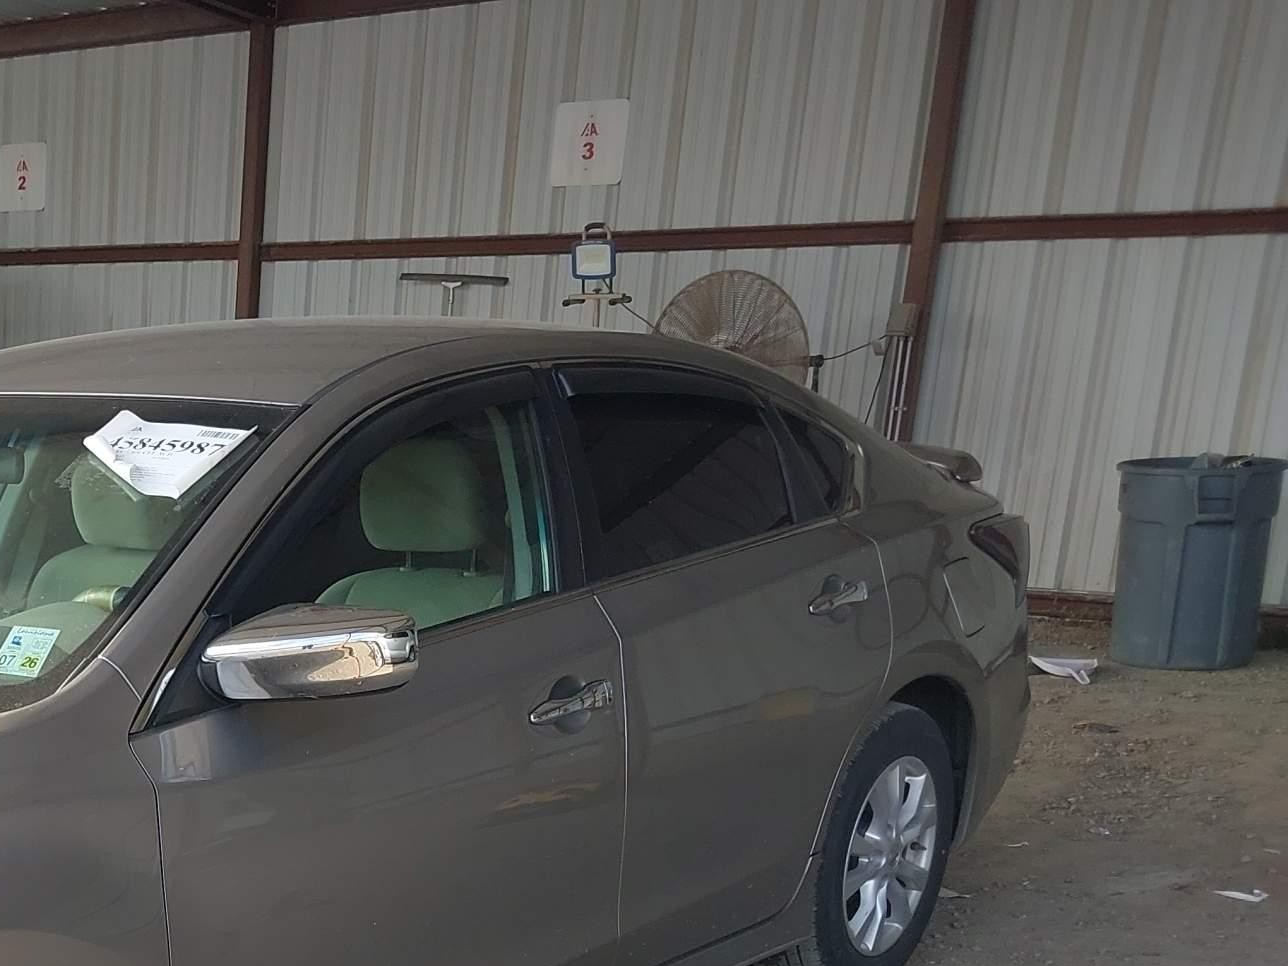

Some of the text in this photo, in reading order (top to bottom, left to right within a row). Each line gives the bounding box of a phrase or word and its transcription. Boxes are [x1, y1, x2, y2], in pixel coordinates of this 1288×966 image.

[581, 142, 595, 160] 3
[18, 175, 27, 191] 2
[110, 436, 228, 456] 45845987
[20, 656, 40, 669] 26
